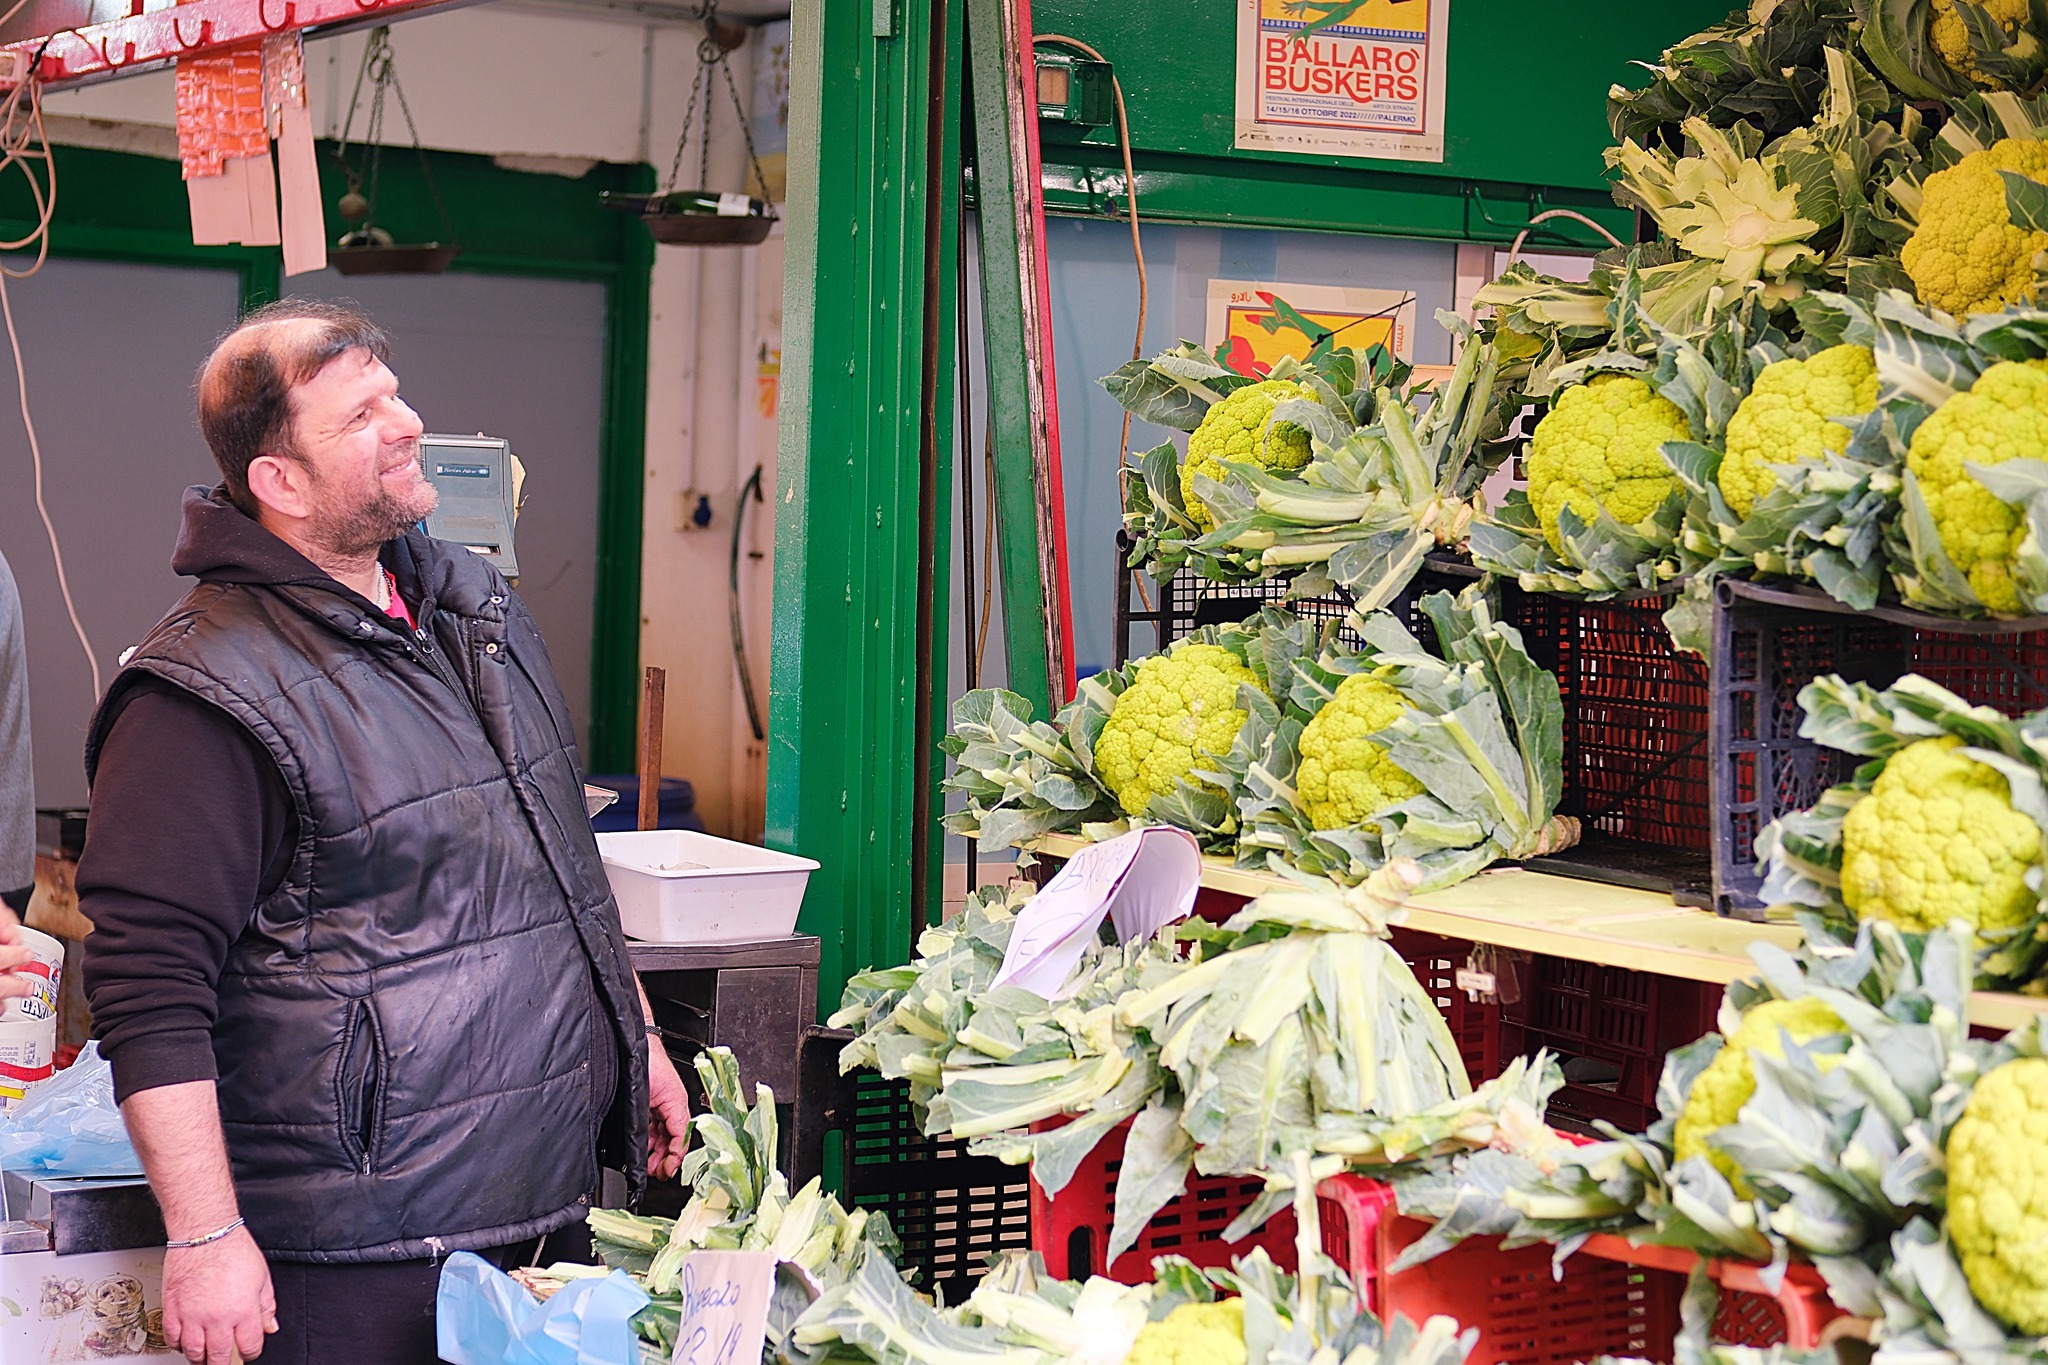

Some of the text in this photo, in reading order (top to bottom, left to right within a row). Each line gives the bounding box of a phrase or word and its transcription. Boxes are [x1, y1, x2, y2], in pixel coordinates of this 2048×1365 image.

[1266, 37, 1420, 74] BALLARÒ
[1265, 65, 1418, 103] BUSKERS
[1266, 95, 1290, 103] FESTIVAL
[1292, 97, 1338, 106] INTERNAZIONALE
[1266, 106, 1300, 115] 14/15/16
[1301, 108, 1338, 118] OTTOBRE
